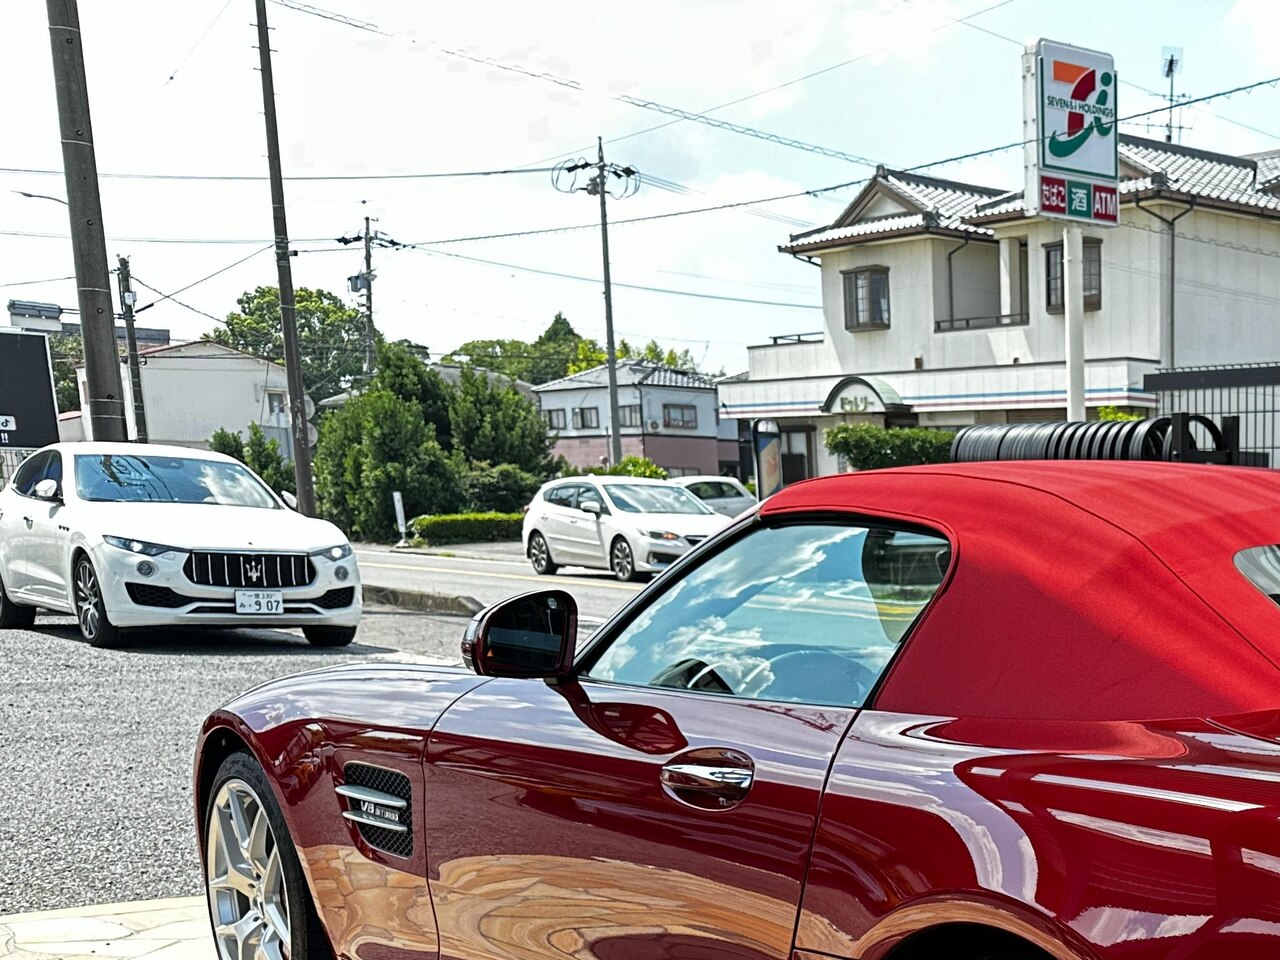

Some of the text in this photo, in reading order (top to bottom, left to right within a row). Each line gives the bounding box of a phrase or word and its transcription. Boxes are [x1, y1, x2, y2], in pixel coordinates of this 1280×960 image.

[1047, 95, 1114, 118] SEVEN&i HOLDINGS
[1042, 181, 1066, 210] たばこ
[1071, 187, 1087, 211] 酒
[1094, 191, 1116, 216] ATM
[360, 801, 375, 814] V8
